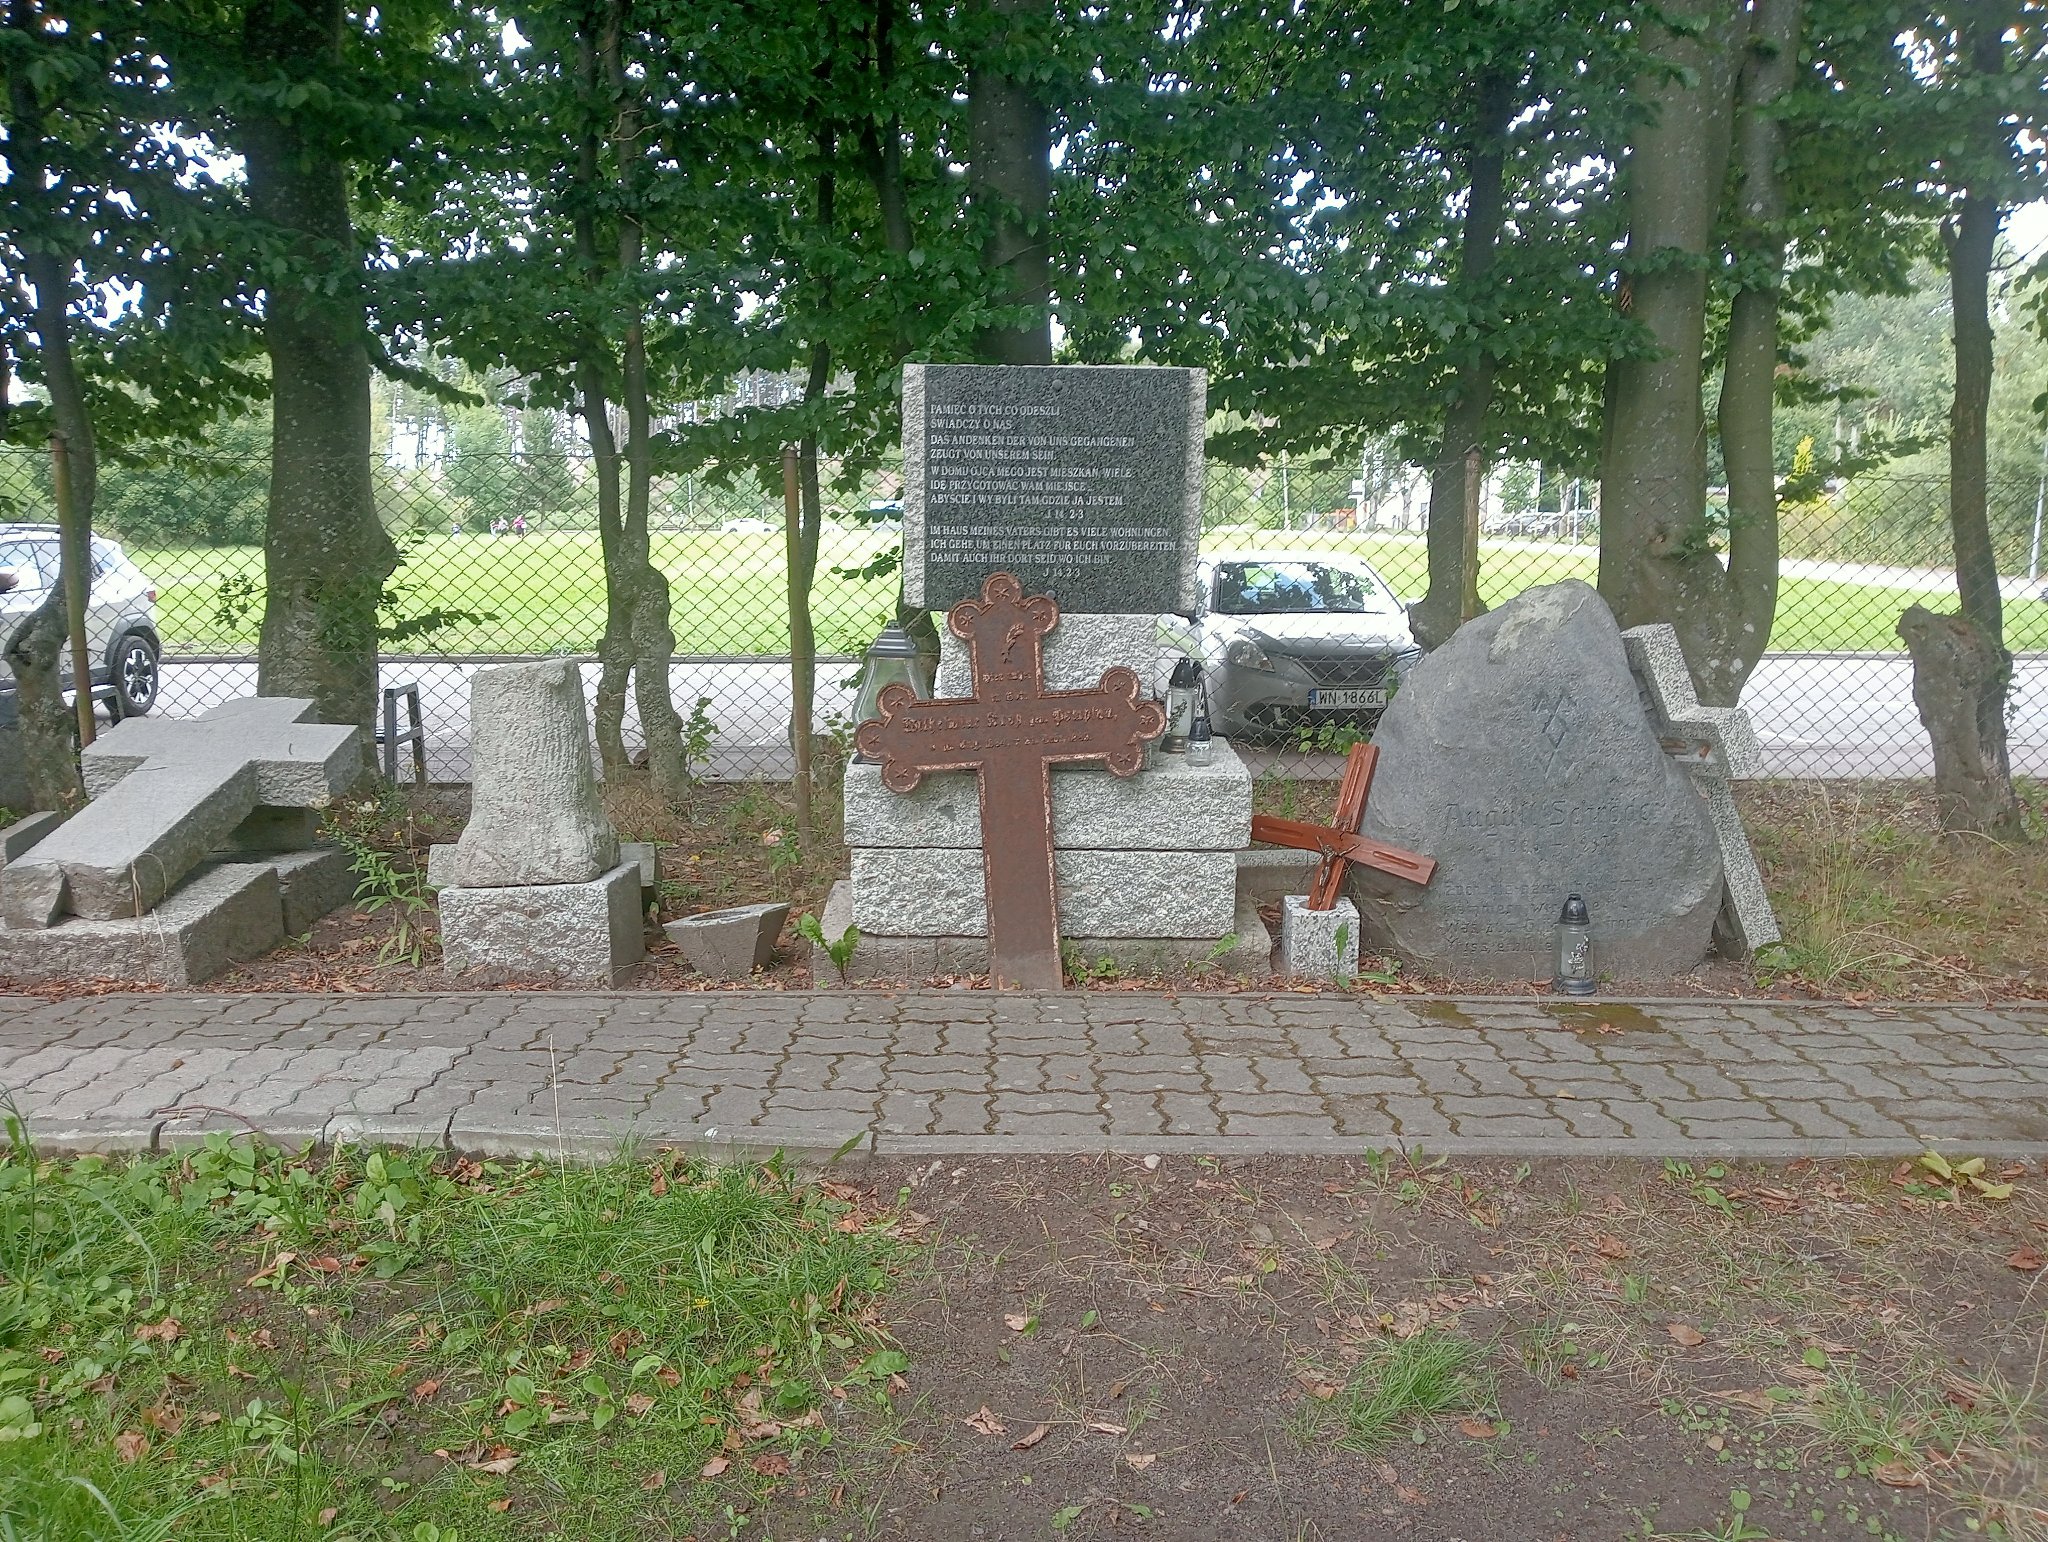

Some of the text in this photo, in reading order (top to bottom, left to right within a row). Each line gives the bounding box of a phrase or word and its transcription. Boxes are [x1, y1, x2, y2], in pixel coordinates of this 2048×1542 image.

[968, 404, 976, 415] O
[977, 404, 1002, 415] TYCH
[1004, 405, 1018, 416] CO
[983, 418, 991, 429] O
[930, 435, 1135, 447] DAS ANDENKEN DER VON UNS GEGANGENEN
[930, 448, 961, 459] ZEUGT
[963, 449, 983, 459] VON
[984, 449, 1030, 460] UNSEREM
[930, 465, 939, 475] W
[941, 465, 969, 476] DOMU
[970, 466, 995, 476] OJCA
[996, 466, 1024, 477] MEGO
[1025, 467, 1048, 478] JEST
[1020, 480, 1044, 491] WAM
[1045, 481, 1087, 492] MIEJSCE
[978, 494, 993, 504] WY
[994, 494, 1017, 505] BYLI
[1042, 495, 1070, 505] GDZIE
[1071, 495, 1084, 506] JA
[930, 525, 941, 535] IM
[942, 525, 968, 536] HAUS
[969, 526, 1005, 536] MEINES
[1006, 526, 1041, 537] VATERS
[1043, 527, 1065, 537] GIBT
[1066, 527, 1079, 537] ES
[1081, 527, 1108, 537] VIELE
[930, 539, 946, 549] ICH
[976, 540, 990, 550] UM
[992, 540, 1021, 550] EINEN
[1022, 541, 1051, 551] PLATZ
[1073, 541, 1098, 551] EUCH
[930, 553, 960, 563] DAMIT
[962, 553, 988, 563] AUCH
[989, 553, 1006, 563] IHR
[1007, 554, 1032, 564] DORT
[1058, 554, 1073, 564] WO
[1074, 554, 1091, 564] ICH
[1042, 567, 1050, 577] J
[1319, 691, 1384, 705] WN 1866L
